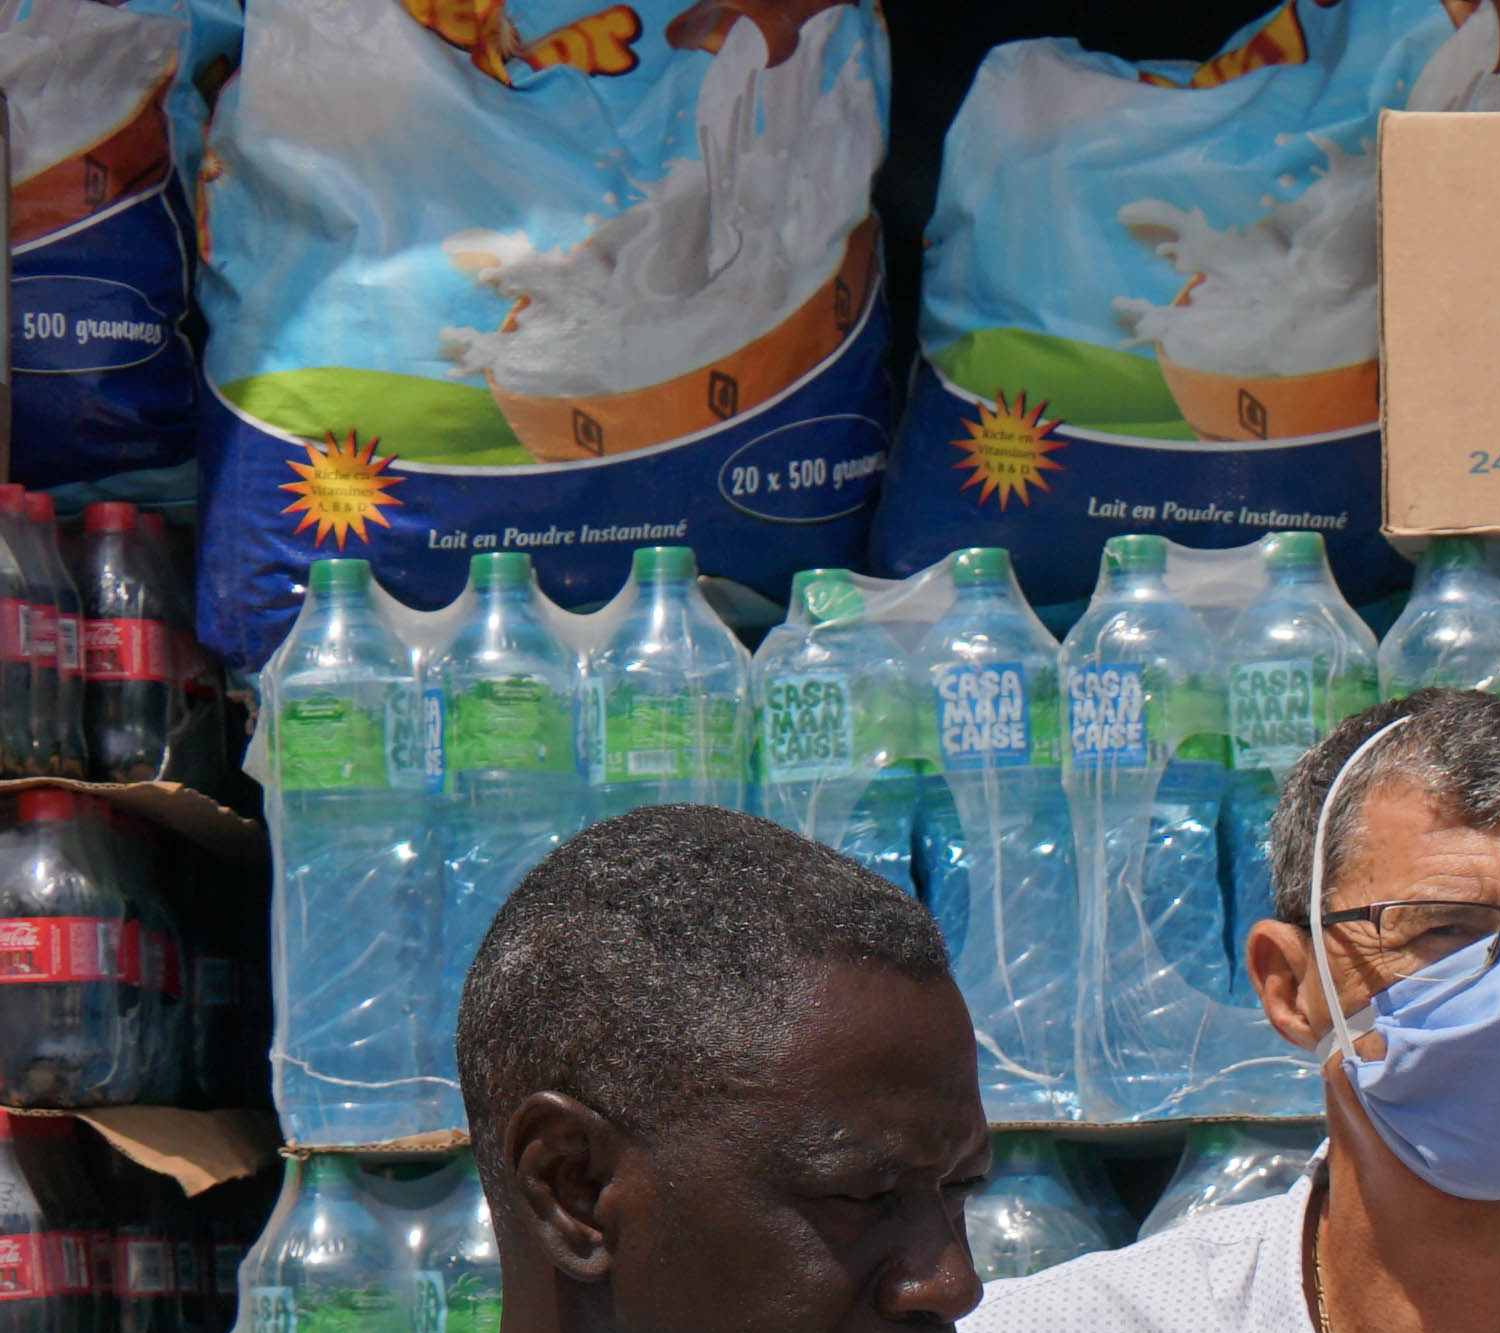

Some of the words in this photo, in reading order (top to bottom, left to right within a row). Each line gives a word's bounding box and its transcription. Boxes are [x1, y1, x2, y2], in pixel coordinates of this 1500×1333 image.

[23, 313, 66, 340] 500
[76, 318, 162, 344] grammes
[731, 471, 758, 495] 20
[768, 474, 780, 490] x
[789, 458, 825, 487] 500
[1088, 497, 1126, 518] Lait
[1132, 504, 1155, 519] en
[1163, 502, 1232, 523] Poudre
[1240, 507, 1348, 529] Instantané
[429, 529, 466, 549] Lait
[473, 532, 496, 548] en
[504, 525, 575, 547] Poudre
[580, 518, 687, 543] Instantané
[937, 670, 1021, 701] CASA
[1070, 670, 1140, 699] CASA
[943, 698, 1023, 728] MAN
[1073, 698, 1142, 728] MAN
[942, 723, 1026, 752] CAISE
[1070, 724, 1143, 751] CAISE
